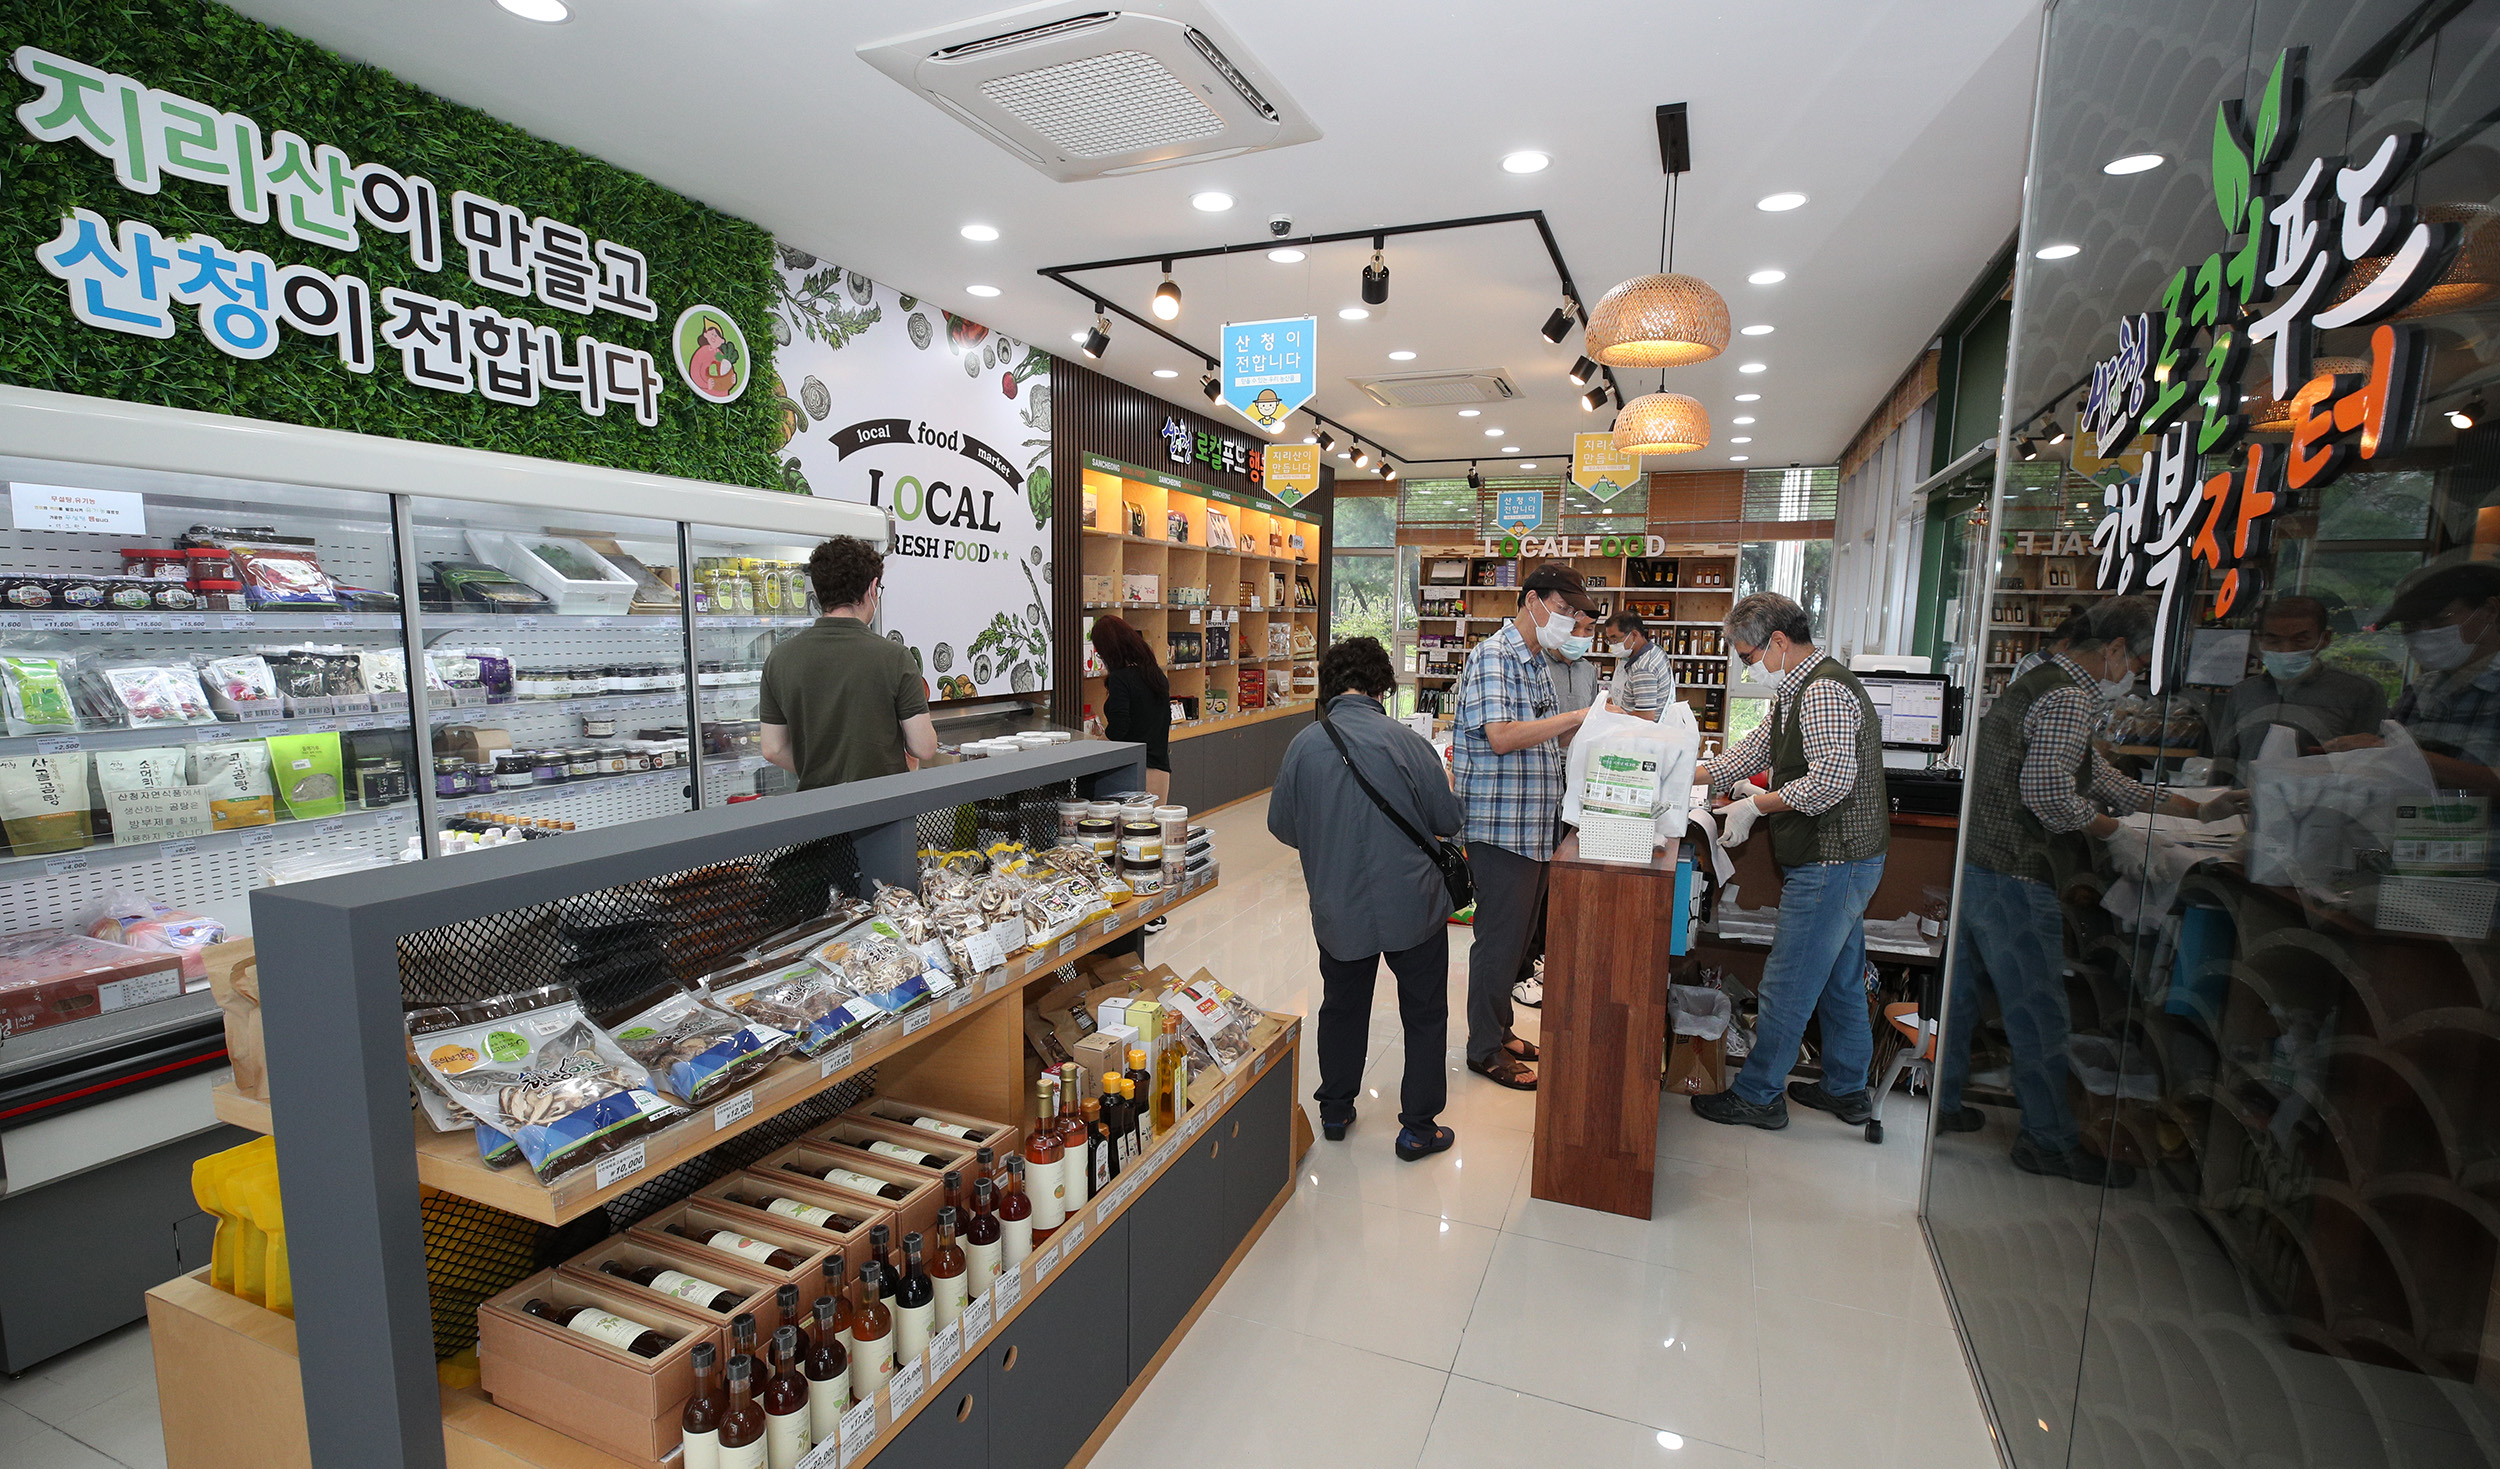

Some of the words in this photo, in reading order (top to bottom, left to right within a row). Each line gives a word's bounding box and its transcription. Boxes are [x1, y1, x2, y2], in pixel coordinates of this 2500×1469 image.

[28, 56, 436, 265] 지리산이
[461, 200, 652, 314] 만들고
[2140, 134, 2430, 455] 로컬푸드
[50, 216, 366, 367] 산청이
[390, 295, 659, 421] 전합니다
[1235, 352, 1301, 373] 전합니다
[855, 423, 891, 444] local
[917, 421, 958, 452] food
[977, 445, 1011, 479] market
[1196, 431, 1246, 474] 로컬푸드
[1273, 450, 1312, 462] 지리산이
[1272, 462, 1312, 474] 만듭니다
[868, 468, 1002, 535] LOCAL
[1504, 505, 1536, 514] 전합니다
[2094, 326, 2395, 696] 행복장터
[944, 539, 991, 564] FOOD
[1485, 535, 1577, 558] LOCAL
[1584, 535, 1666, 558] FOOD
[123, 804, 164, 816] 생산하는
[128, 818, 174, 830] 방부제를
[121, 832, 161, 844] 사용하지
[166, 828, 204, 839] 않습니다
[726, 1101, 753, 1119] ₩12,000
[610, 1155, 643, 1177] ₩10,000
[850, 1404, 875, 1430] ₩17,000
